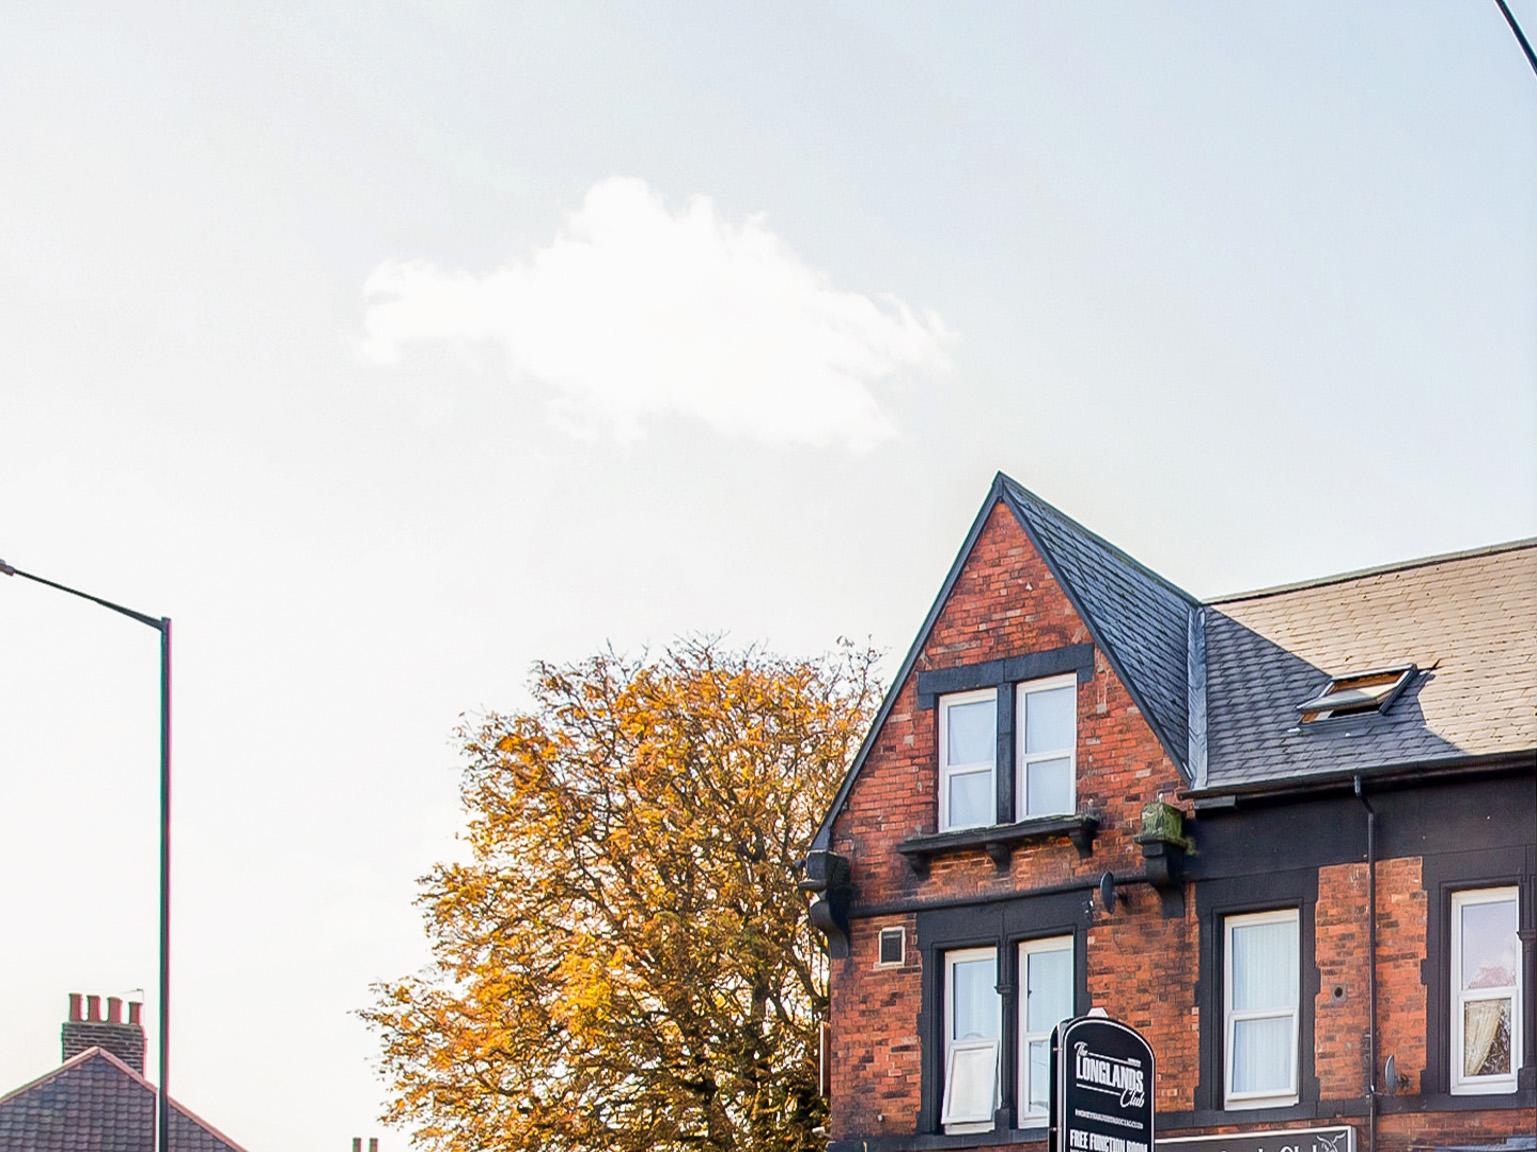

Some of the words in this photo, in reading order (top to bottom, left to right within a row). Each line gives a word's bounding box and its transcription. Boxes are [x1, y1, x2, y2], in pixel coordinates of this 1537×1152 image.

[1076, 1055, 1144, 1093] LONGLANDS
[1120, 1088, 1145, 1107] Club
[1070, 1129, 1089, 1149] FREE
